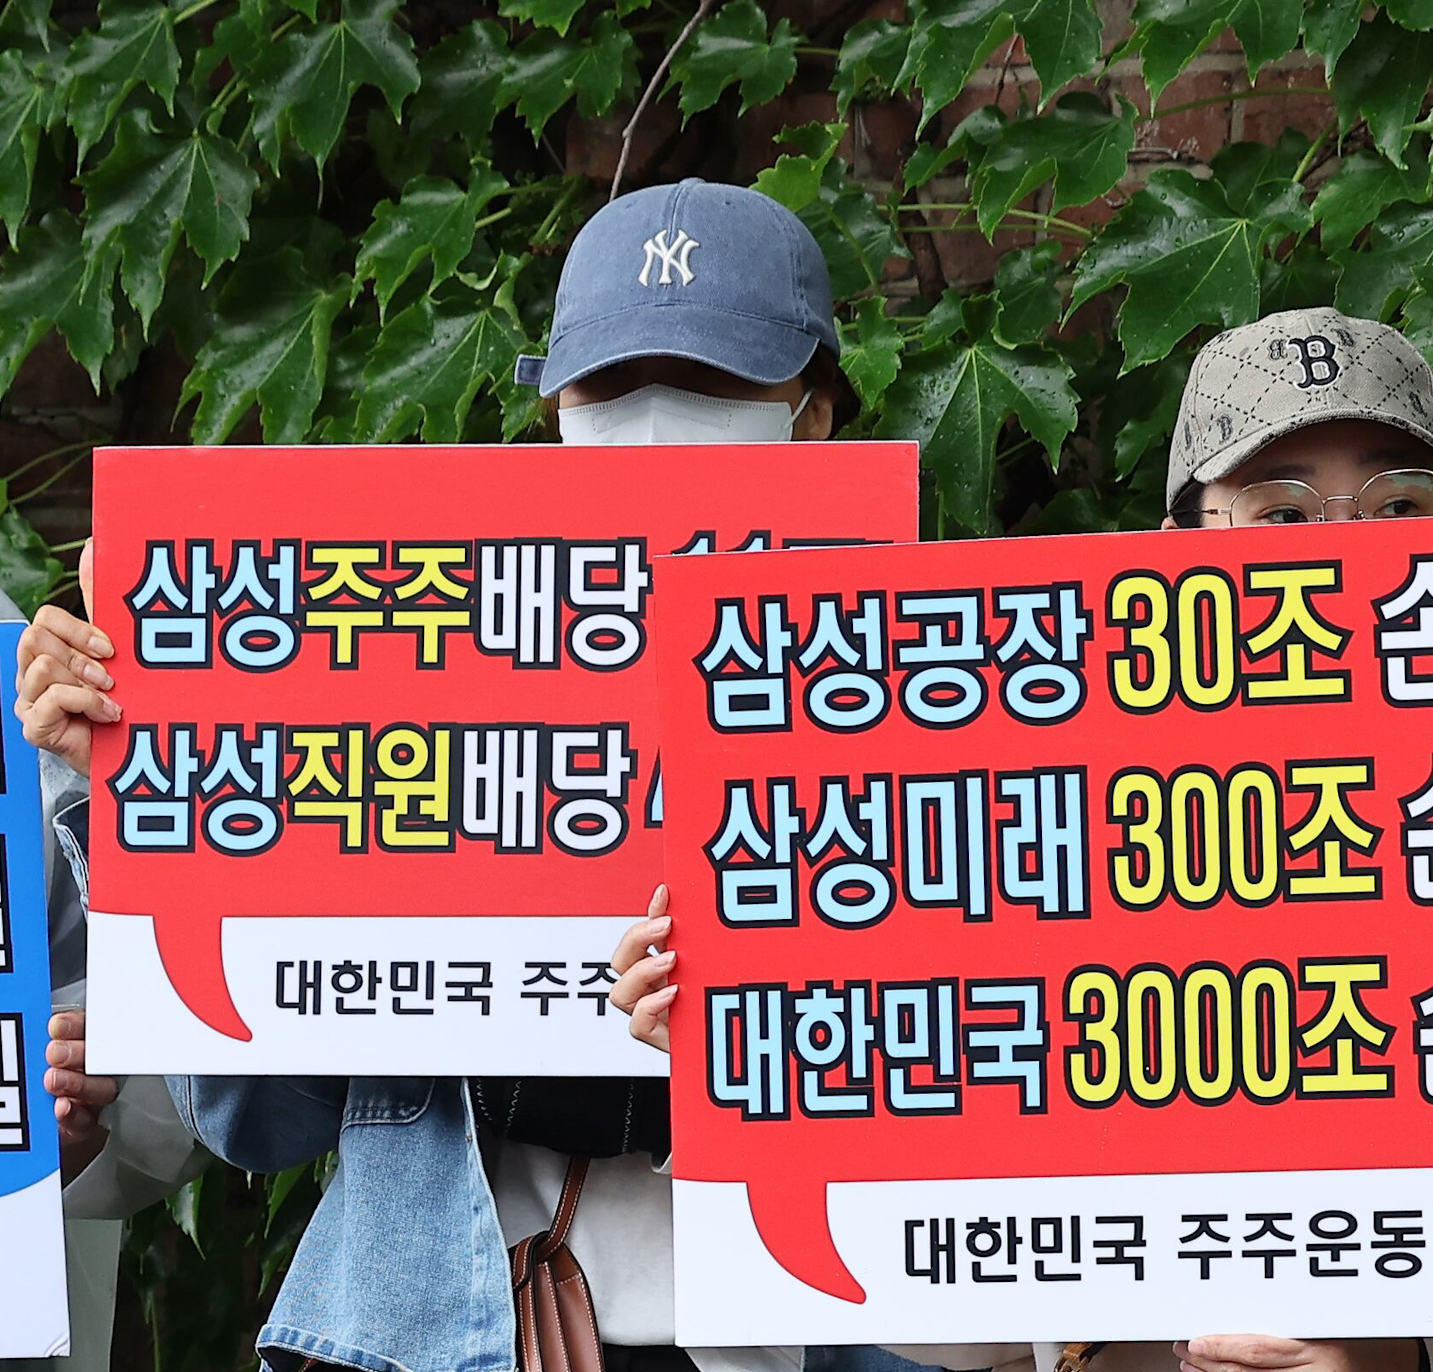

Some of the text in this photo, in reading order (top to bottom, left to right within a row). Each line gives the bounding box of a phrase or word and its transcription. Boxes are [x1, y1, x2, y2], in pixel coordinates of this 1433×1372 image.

[638, 229, 699, 287] NY
[1287, 334, 1341, 390] B
[124, 536, 653, 672] 삼성주주배당
[693, 583, 1095, 732] 삼성공장
[1106, 558, 1352, 713] 30조
[107, 721, 638, 857] 삼성직원배당
[706, 763, 1092, 928] 삼성미래
[1108, 758, 1381, 911] 300조
[275, 960, 493, 1016] 대한민국
[705, 976, 1050, 1121] 대한민국
[1063, 955, 1396, 1111] 3000조
[903, 1213, 1148, 1285] 대한민국
